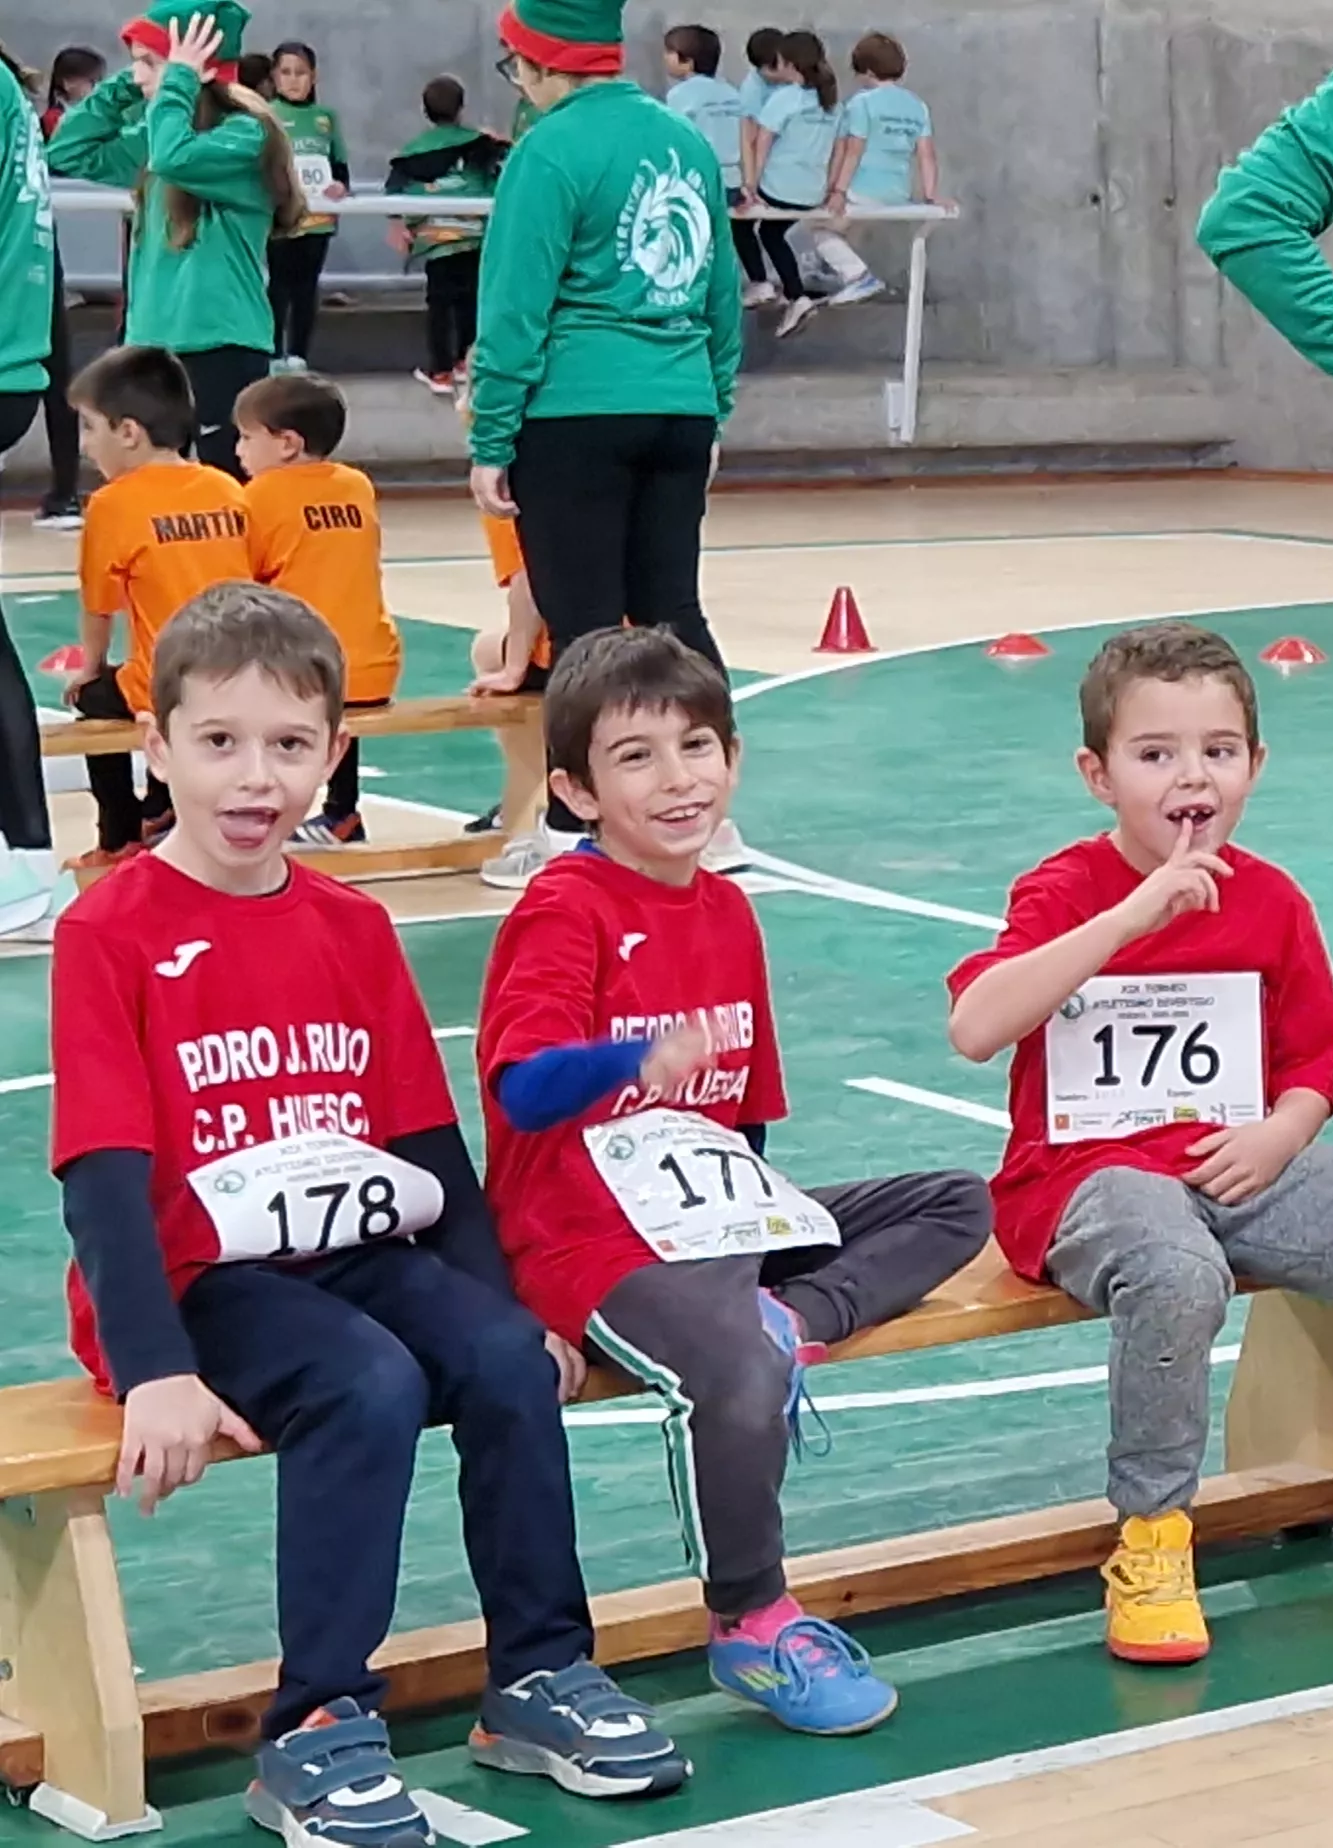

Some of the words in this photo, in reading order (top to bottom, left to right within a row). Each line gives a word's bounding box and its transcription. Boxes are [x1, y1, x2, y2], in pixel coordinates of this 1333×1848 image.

[303, 503, 363, 531] CIRO
[176, 1025, 280, 1093] PDRO
[1093, 1021, 1221, 1087] 176
[658, 1147, 773, 1209] 177
[266, 1174, 400, 1259] 178
